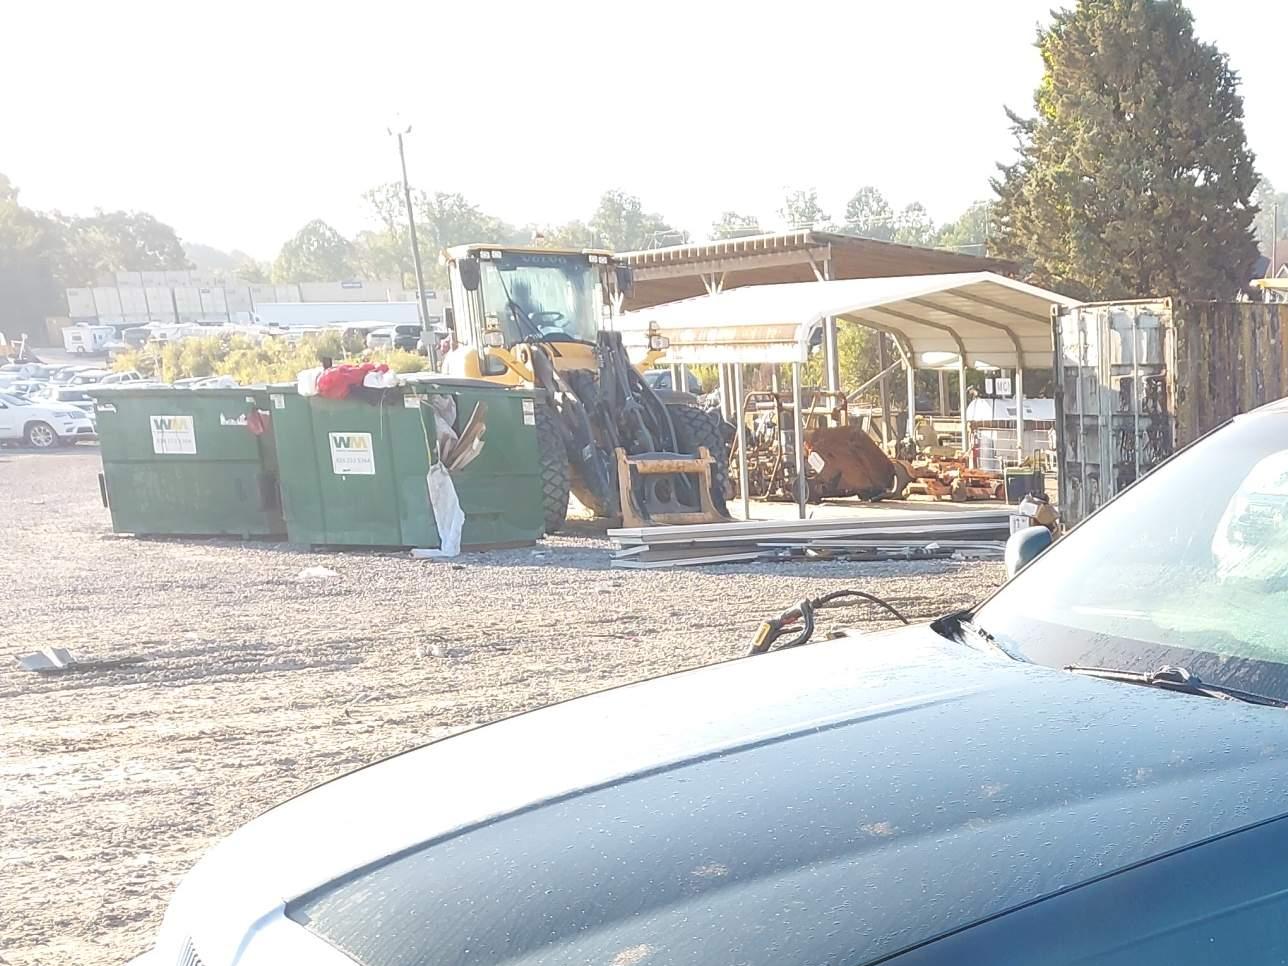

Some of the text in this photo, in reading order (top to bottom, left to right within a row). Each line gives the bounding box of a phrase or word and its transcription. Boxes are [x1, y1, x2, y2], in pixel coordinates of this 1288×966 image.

[520, 256, 567, 264] VOLVO
[154, 418, 188, 430] WM
[333, 436, 368, 449] WM
